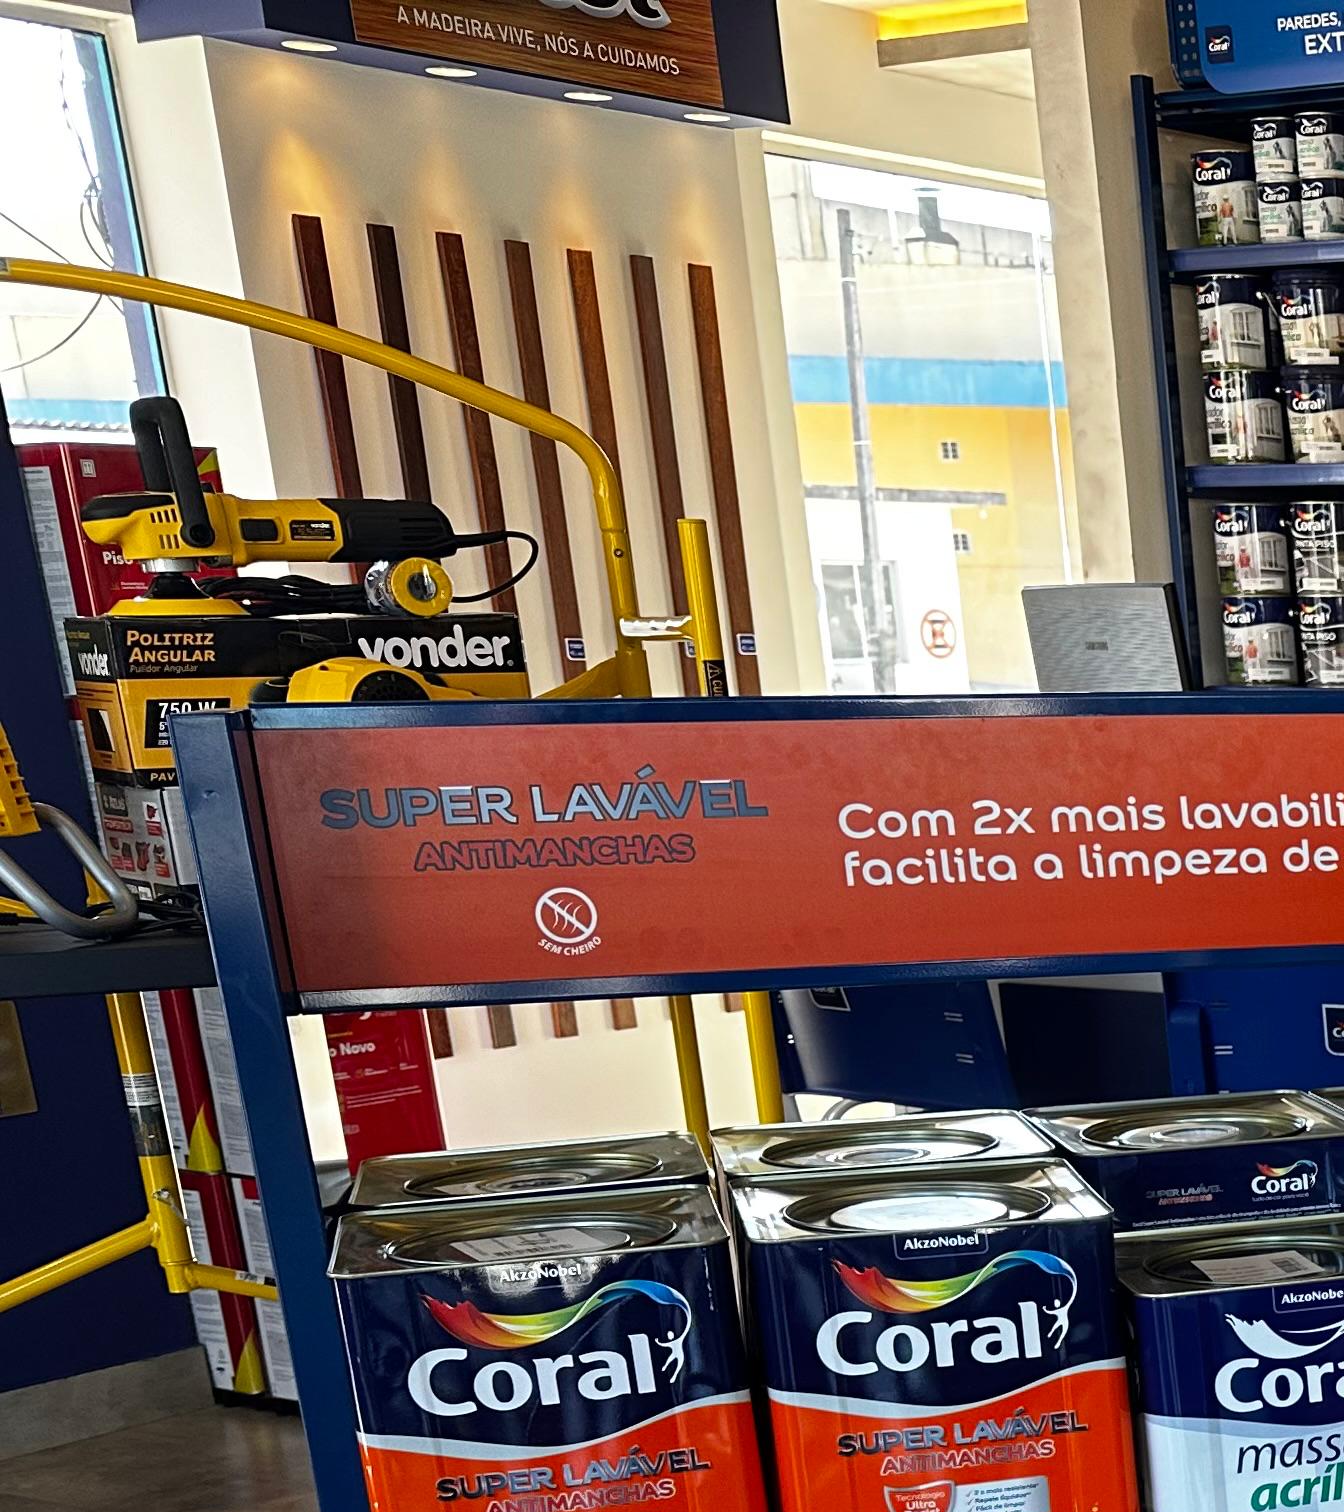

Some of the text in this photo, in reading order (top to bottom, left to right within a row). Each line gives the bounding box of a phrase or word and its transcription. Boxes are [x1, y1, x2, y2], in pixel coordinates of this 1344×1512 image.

[397, 5, 681, 76] A MADEIRA VIVE, NÓS A CUIDAMOS
[1277, 13, 1341, 32] PAREDES,
[126, 629, 215, 647] POLITRIZ
[129, 646, 216, 663] ANGULAR
[358, 624, 510, 668] vonder
[320, 764, 769, 829] SUPER LAVÁVEL
[837, 802, 955, 840] Com
[973, 799, 1036, 837] 2x
[1051, 797, 1166, 834] mais
[414, 833, 695, 872] ANTIMANCHAS
[845, 846, 1017, 887] facilita
[1033, 852, 1063, 881] a
[1079, 842, 1267, 885] limpeza
[1282, 838, 1339, 873] de
[537, 935, 602, 956] SEM CHEIRO
[1250, 1172, 1309, 1196] Coral
[903, 1233, 979, 1250] AkzoNobel
[815, 1300, 1045, 1377] Coral
[407, 1334, 657, 1417] Coral
[435, 1443, 712, 1502] SUPER LAVÁVEL
